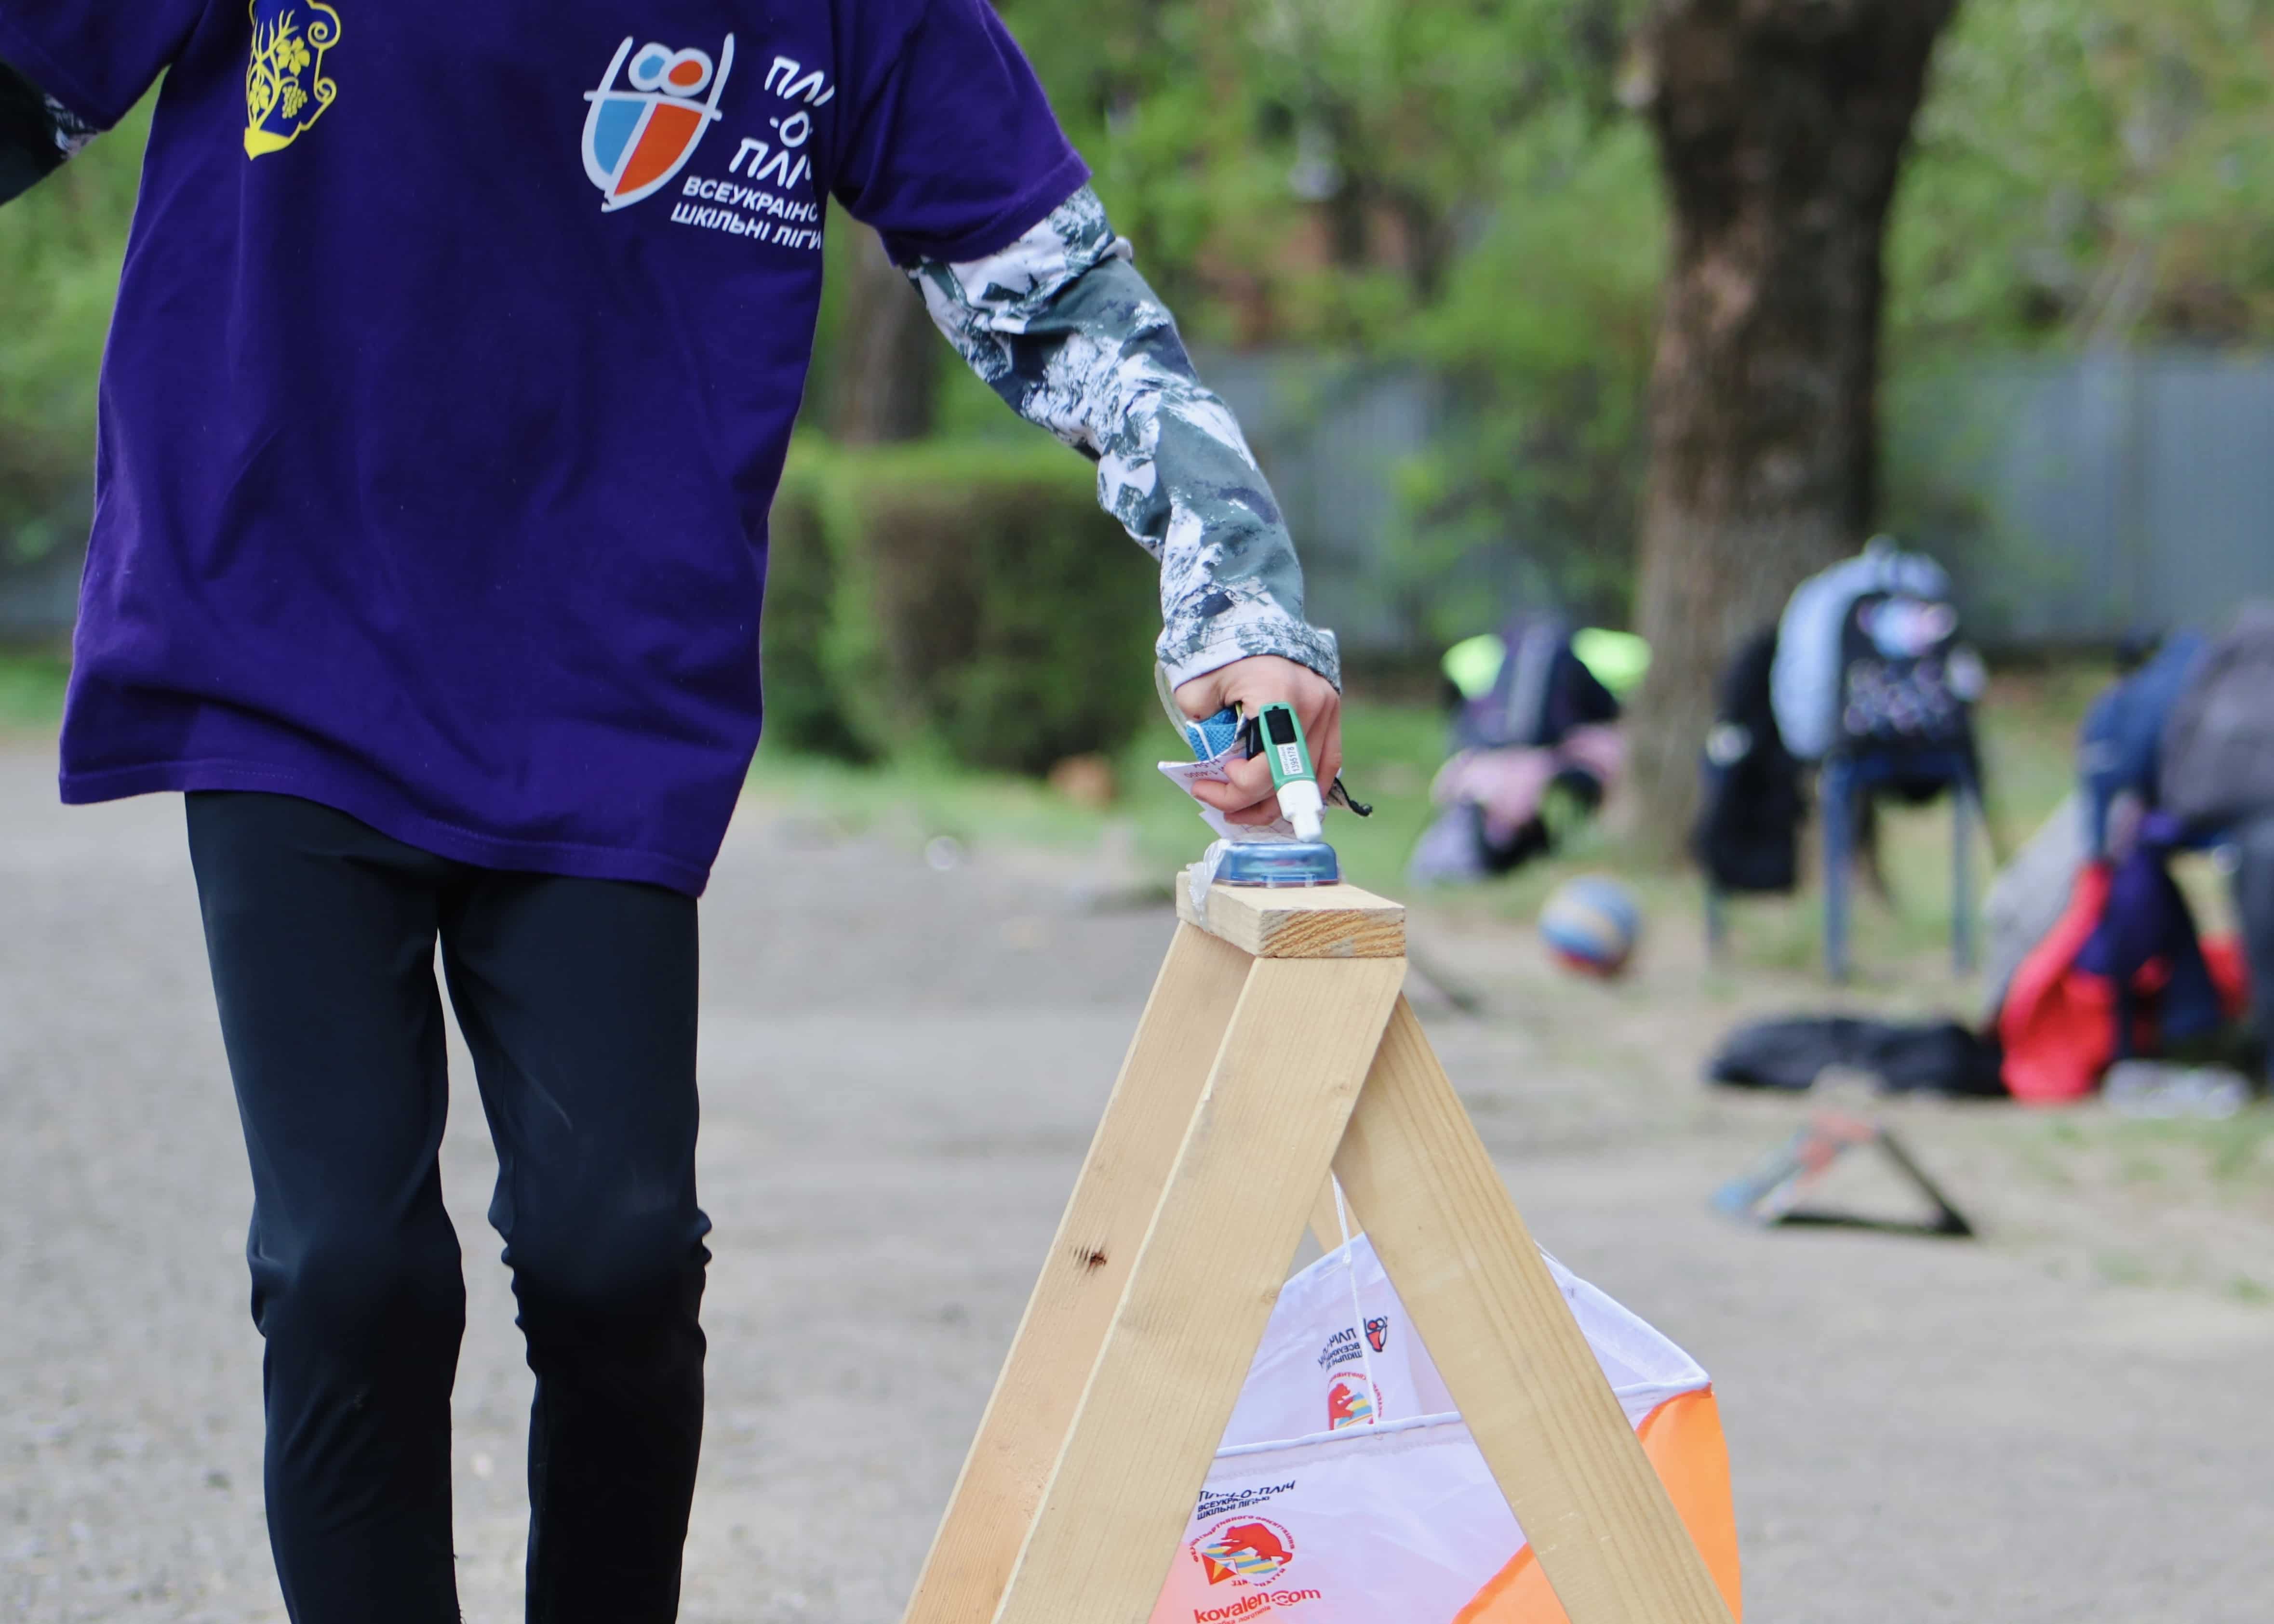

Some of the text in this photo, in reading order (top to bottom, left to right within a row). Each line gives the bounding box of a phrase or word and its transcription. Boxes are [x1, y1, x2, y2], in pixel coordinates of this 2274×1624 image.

[670, 201, 771, 241] ШКІЛЬНІ
[1197, 1500, 1258, 1520] ШКІЛЬНІ ЛІГ
